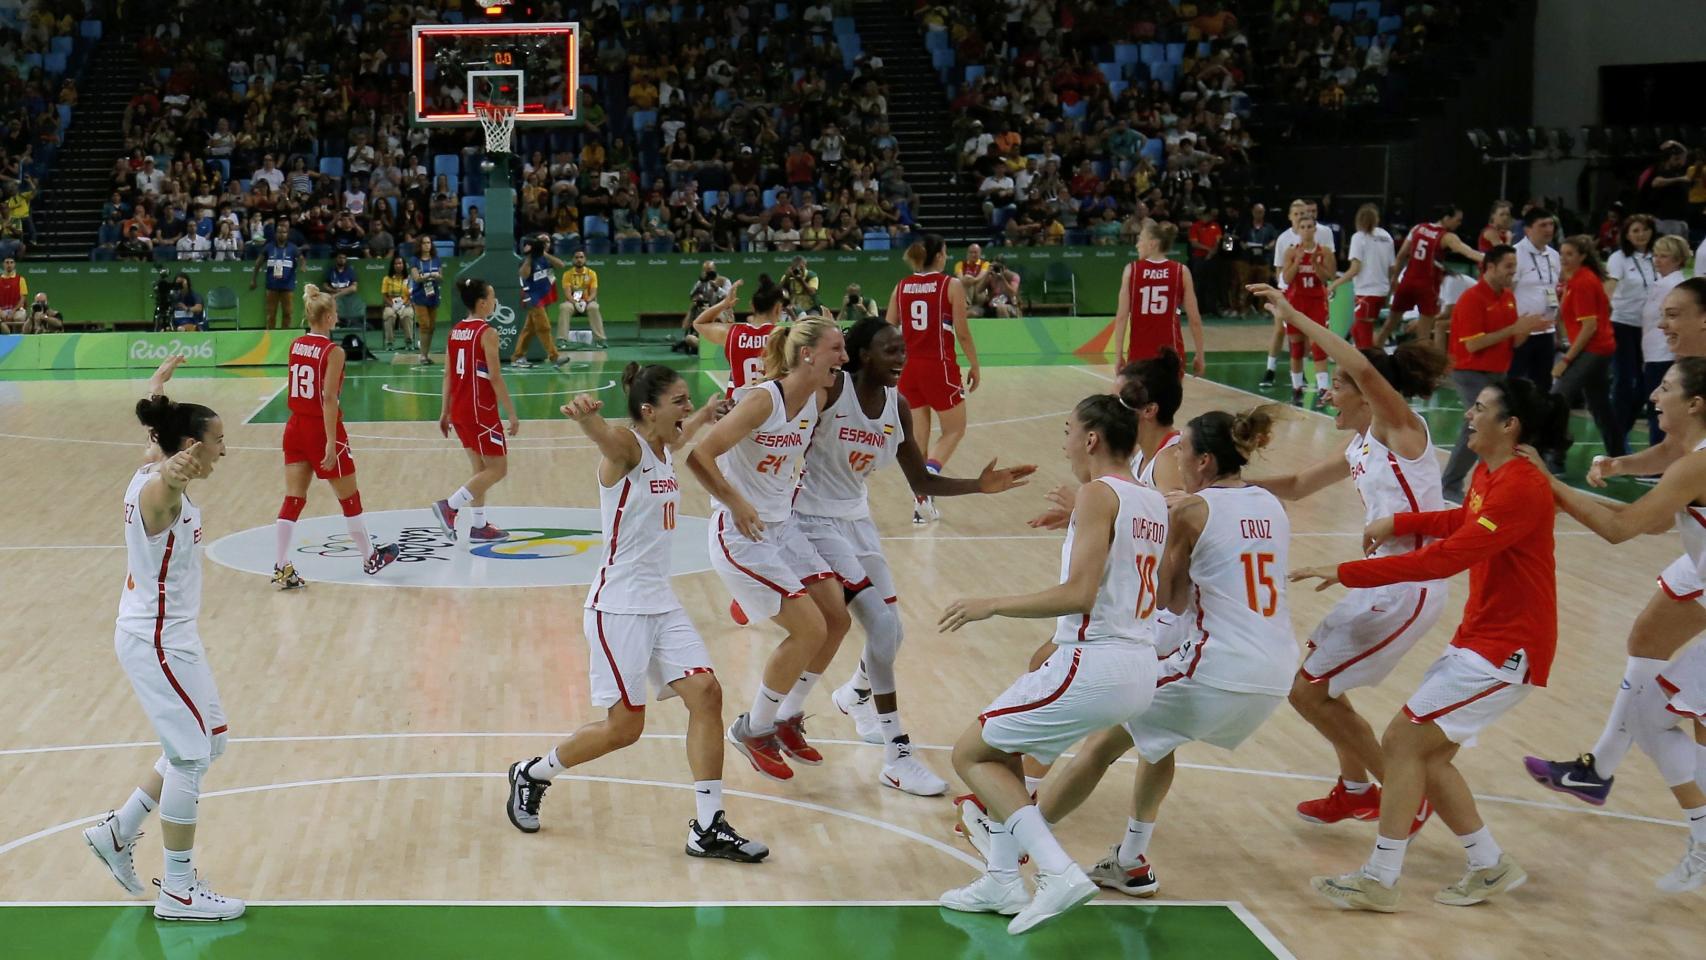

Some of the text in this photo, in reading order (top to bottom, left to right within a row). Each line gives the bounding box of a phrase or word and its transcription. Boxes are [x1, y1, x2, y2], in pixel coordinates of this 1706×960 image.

[495, 52, 512, 65] 0.0
[1414, 239, 1429, 260] 5
[1143, 268, 1169, 279] PAGE
[1139, 285, 1169, 315] 15
[910, 300, 928, 331] 9
[130, 338, 213, 360] Rio2016
[456, 348, 465, 379] 4
[290, 363, 315, 400] 13
[754, 431, 803, 448] ESPAÑA
[662, 501, 676, 530] 10
[1240, 519, 1272, 540] CRUZ
[1239, 553, 1278, 618] 15
